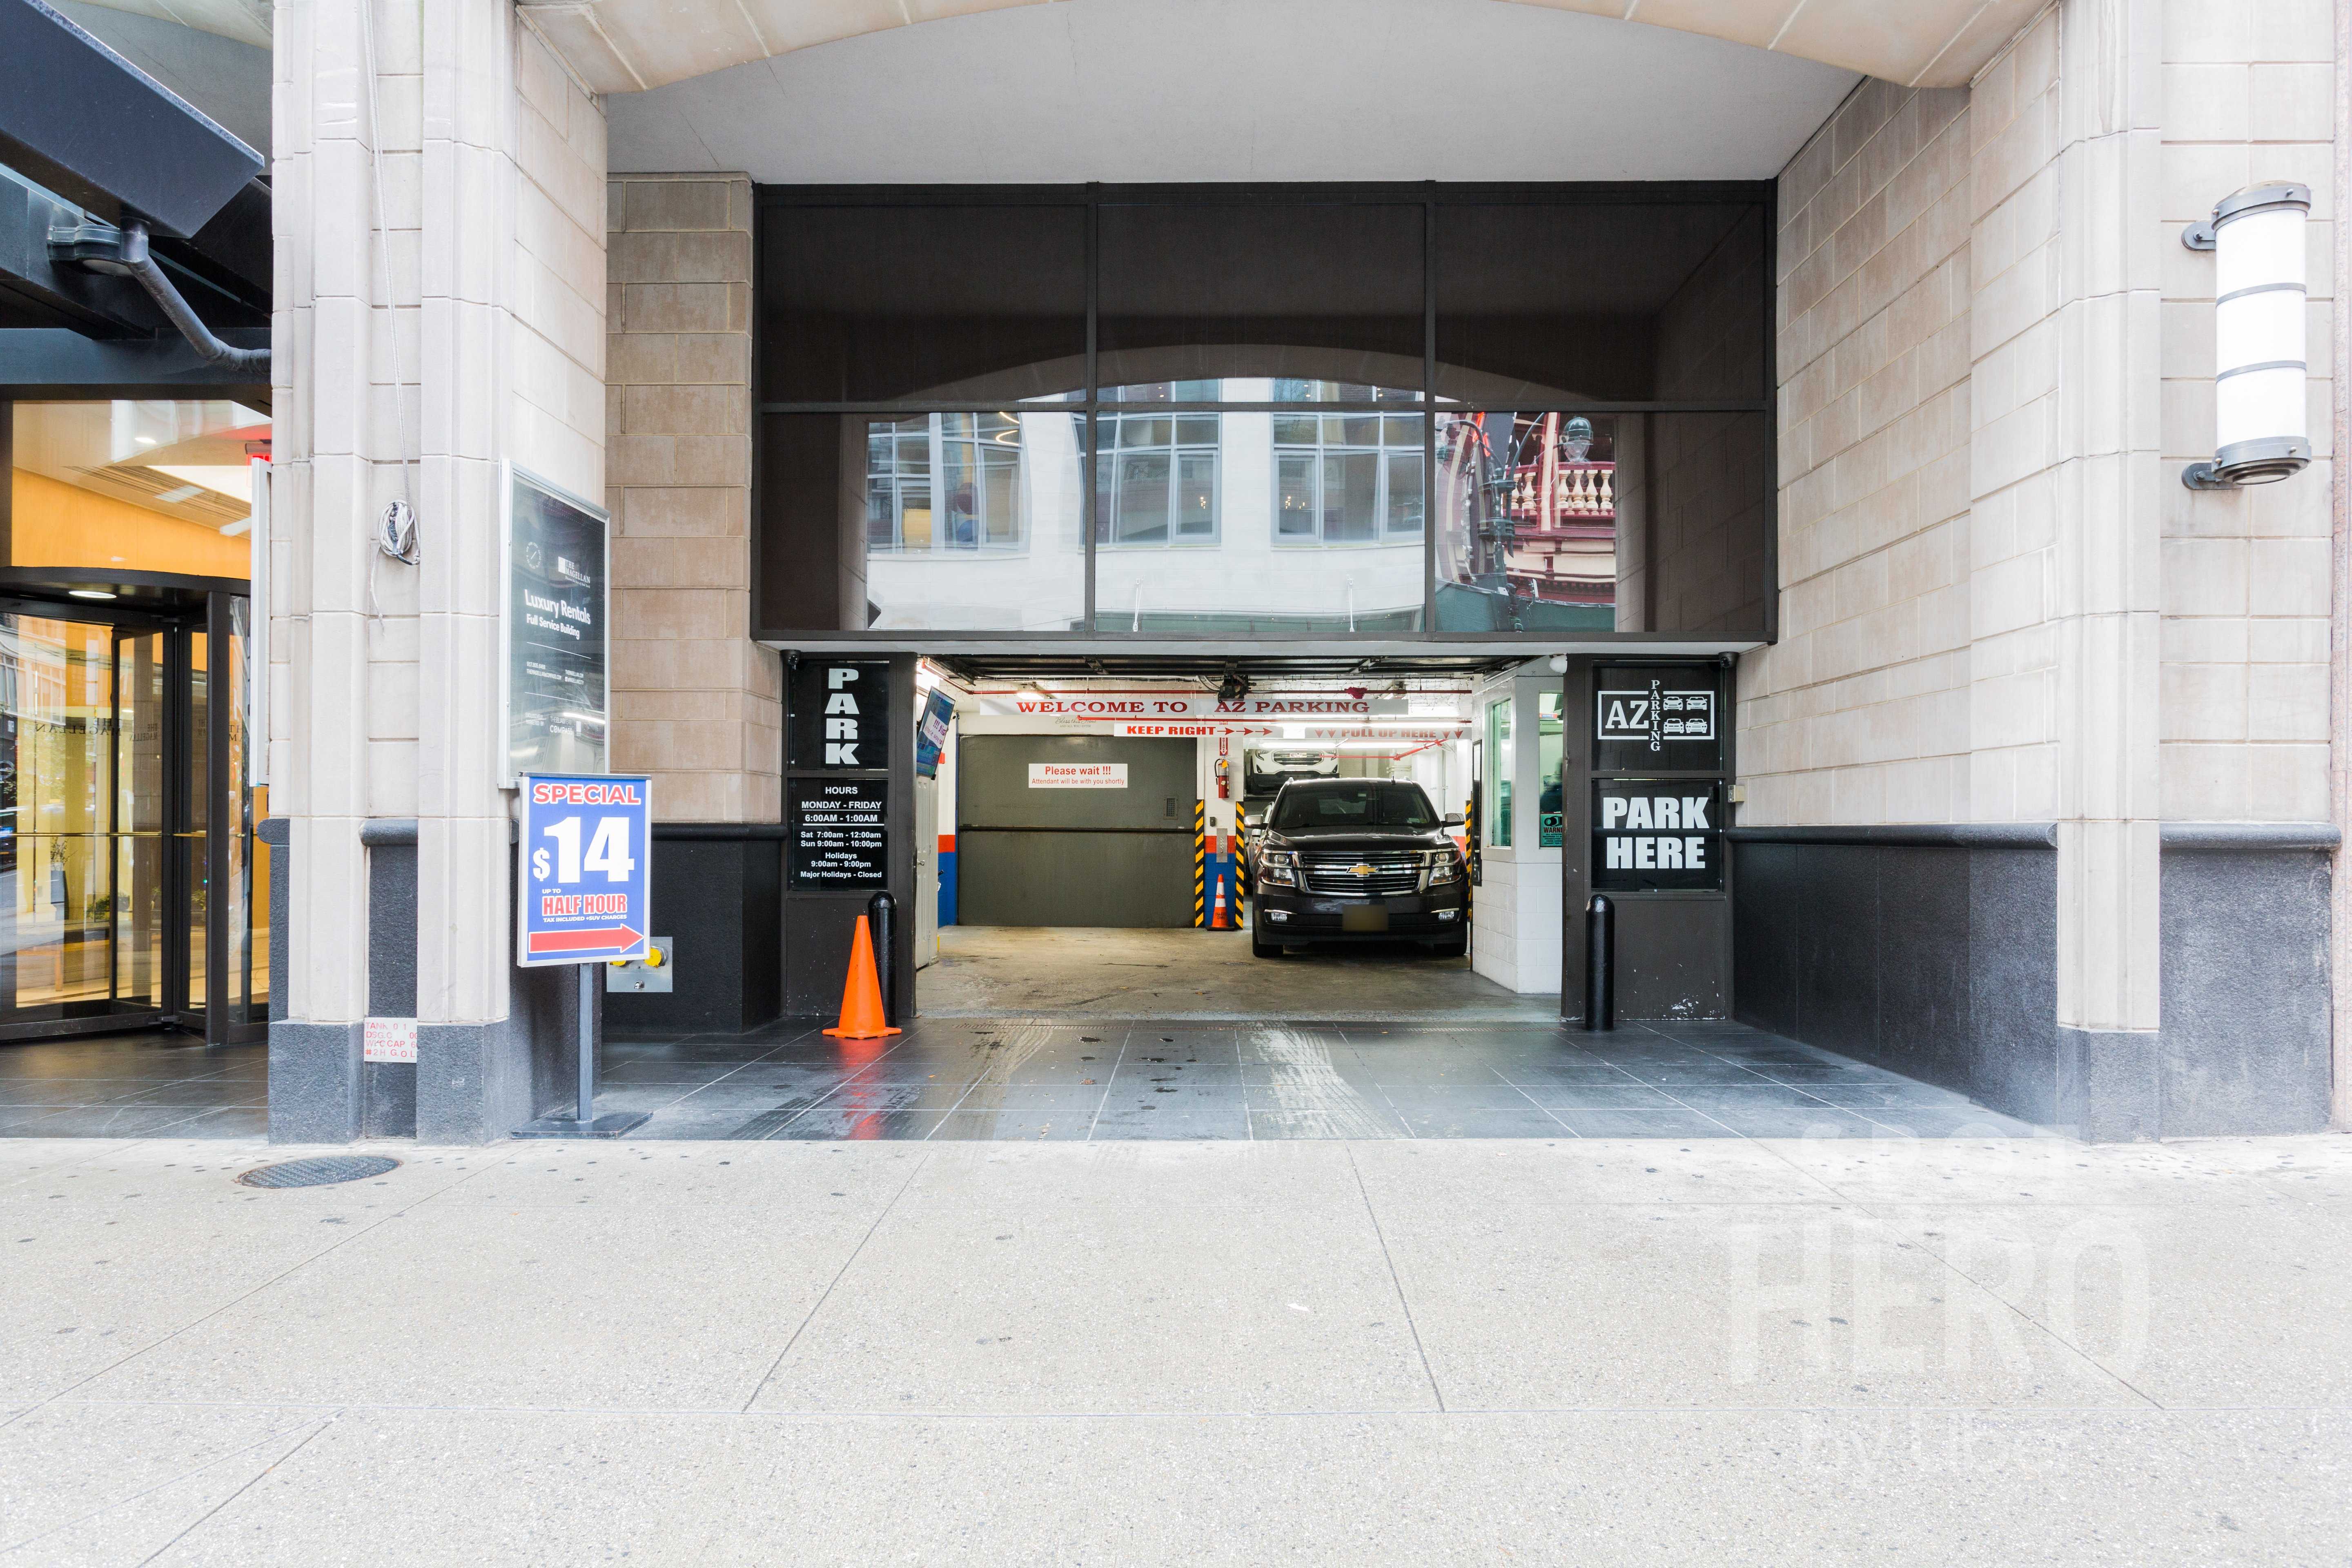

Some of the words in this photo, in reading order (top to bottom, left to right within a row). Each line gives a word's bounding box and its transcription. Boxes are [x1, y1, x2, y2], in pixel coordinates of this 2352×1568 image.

[566, 559, 574, 569] THE
[566, 568, 590, 583] MAGELLAN
[525, 589, 559, 619] Luxury
[561, 600, 591, 624] Rentals
[526, 613, 538, 625] Full
[539, 617, 559, 631] Service
[560, 622, 580, 640] Building
[824, 668, 860, 764] PARK
[1016, 702, 1145, 712] WELCOME
[1153, 702, 1187, 712] TO
[1214, 702, 1246, 713] AZ
[1255, 702, 1370, 713] PARKING
[1605, 700, 1649, 729] AZ
[1650, 679, 1661, 751] PARKING
[550, 725, 572, 735] COMPASS
[1127, 726, 1164, 734] KEEP
[1169, 726, 1216, 735] RIGHT
[1341, 728, 1374, 737] PULL
[1378, 729, 1397, 737] UP
[1401, 729, 1436, 738] HERE
[1045, 766, 1076, 775] Please
[1080, 766, 1099, 775] wait
[533, 784, 641, 804] SPECIAL
[1603, 797, 1709, 829] PARK
[850, 840, 882, 849] 10:00pm
[1606, 837, 1706, 869] HERE
[844, 861, 871, 869] 9:00pm
[542, 895, 582, 916] HALF
[584, 893, 627, 914] HOUR
